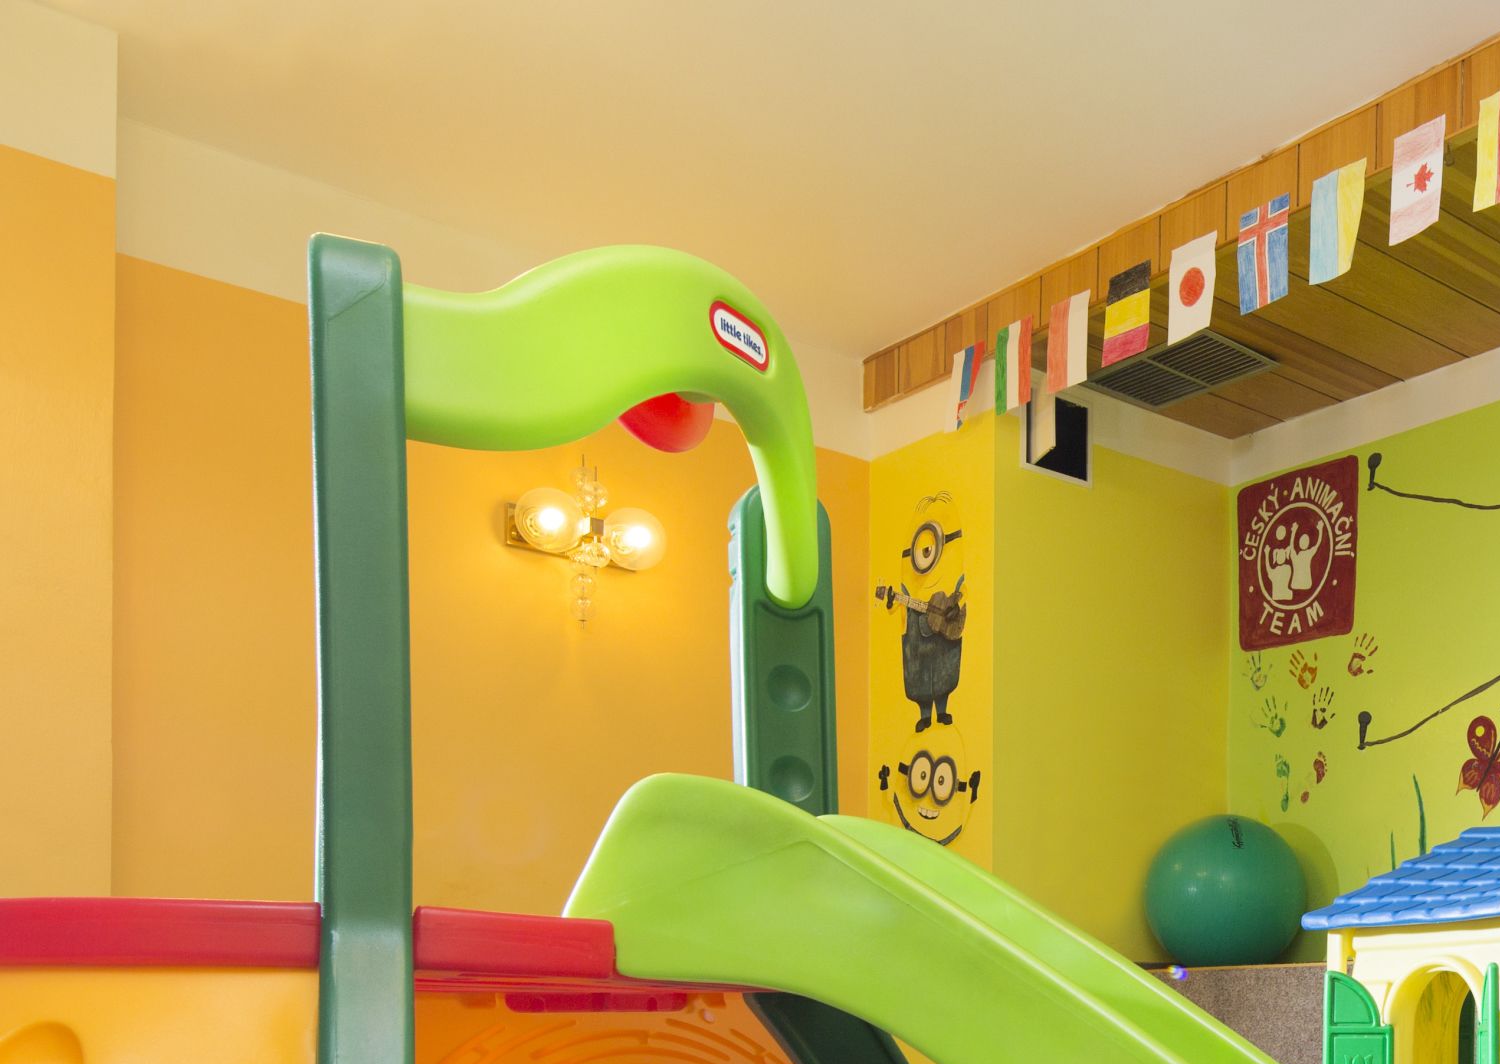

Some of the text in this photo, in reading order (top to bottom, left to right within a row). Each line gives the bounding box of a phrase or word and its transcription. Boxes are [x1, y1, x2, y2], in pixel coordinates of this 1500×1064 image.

[720, 317, 762, 356] little tikes
[1239, 476, 1355, 561] ČESKÝ ANIMAČNÍ
[1259, 600, 1325, 635] TEAM
